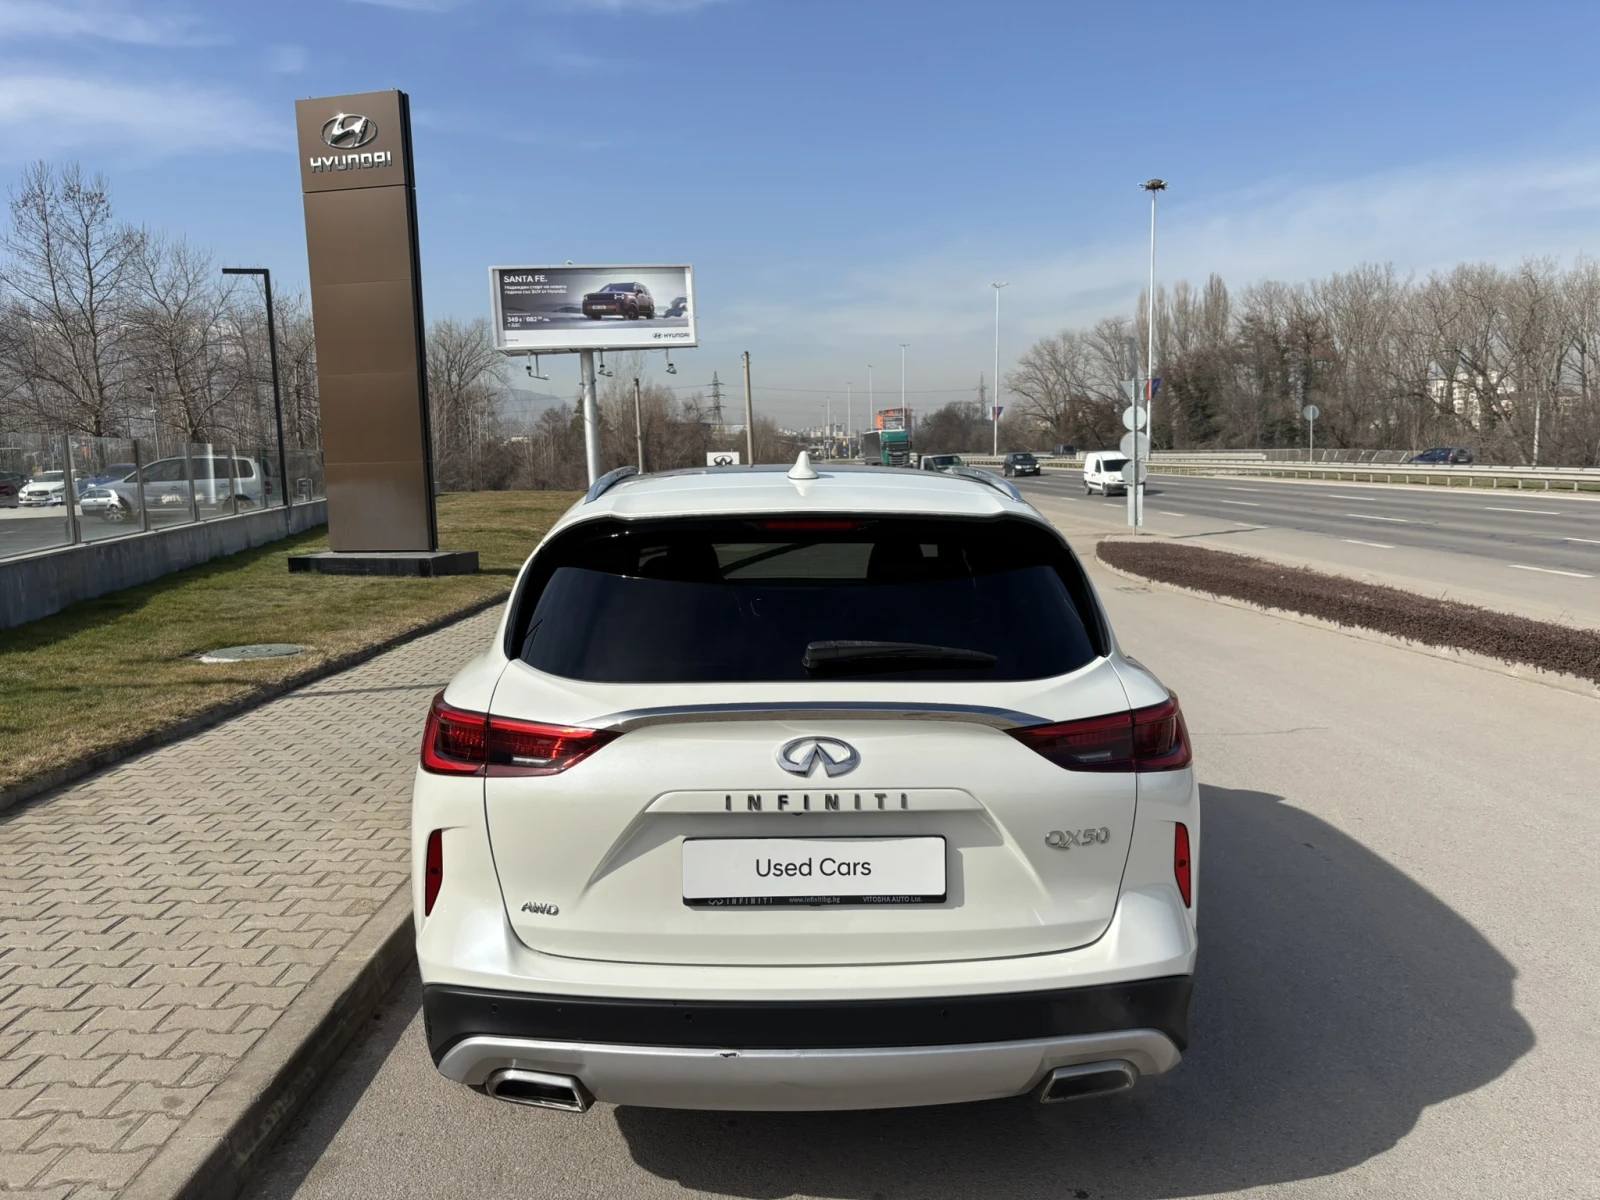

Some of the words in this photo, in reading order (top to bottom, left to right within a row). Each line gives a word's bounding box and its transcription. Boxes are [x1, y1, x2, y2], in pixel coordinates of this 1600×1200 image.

[309, 151, 392, 173] HYUNDAI
[725, 793, 909, 812] INFINITI
[1045, 827, 1110, 851] QX50
[755, 857, 812, 877] Used
[819, 857, 872, 876] Cars
[521, 901, 560, 916] AWD
